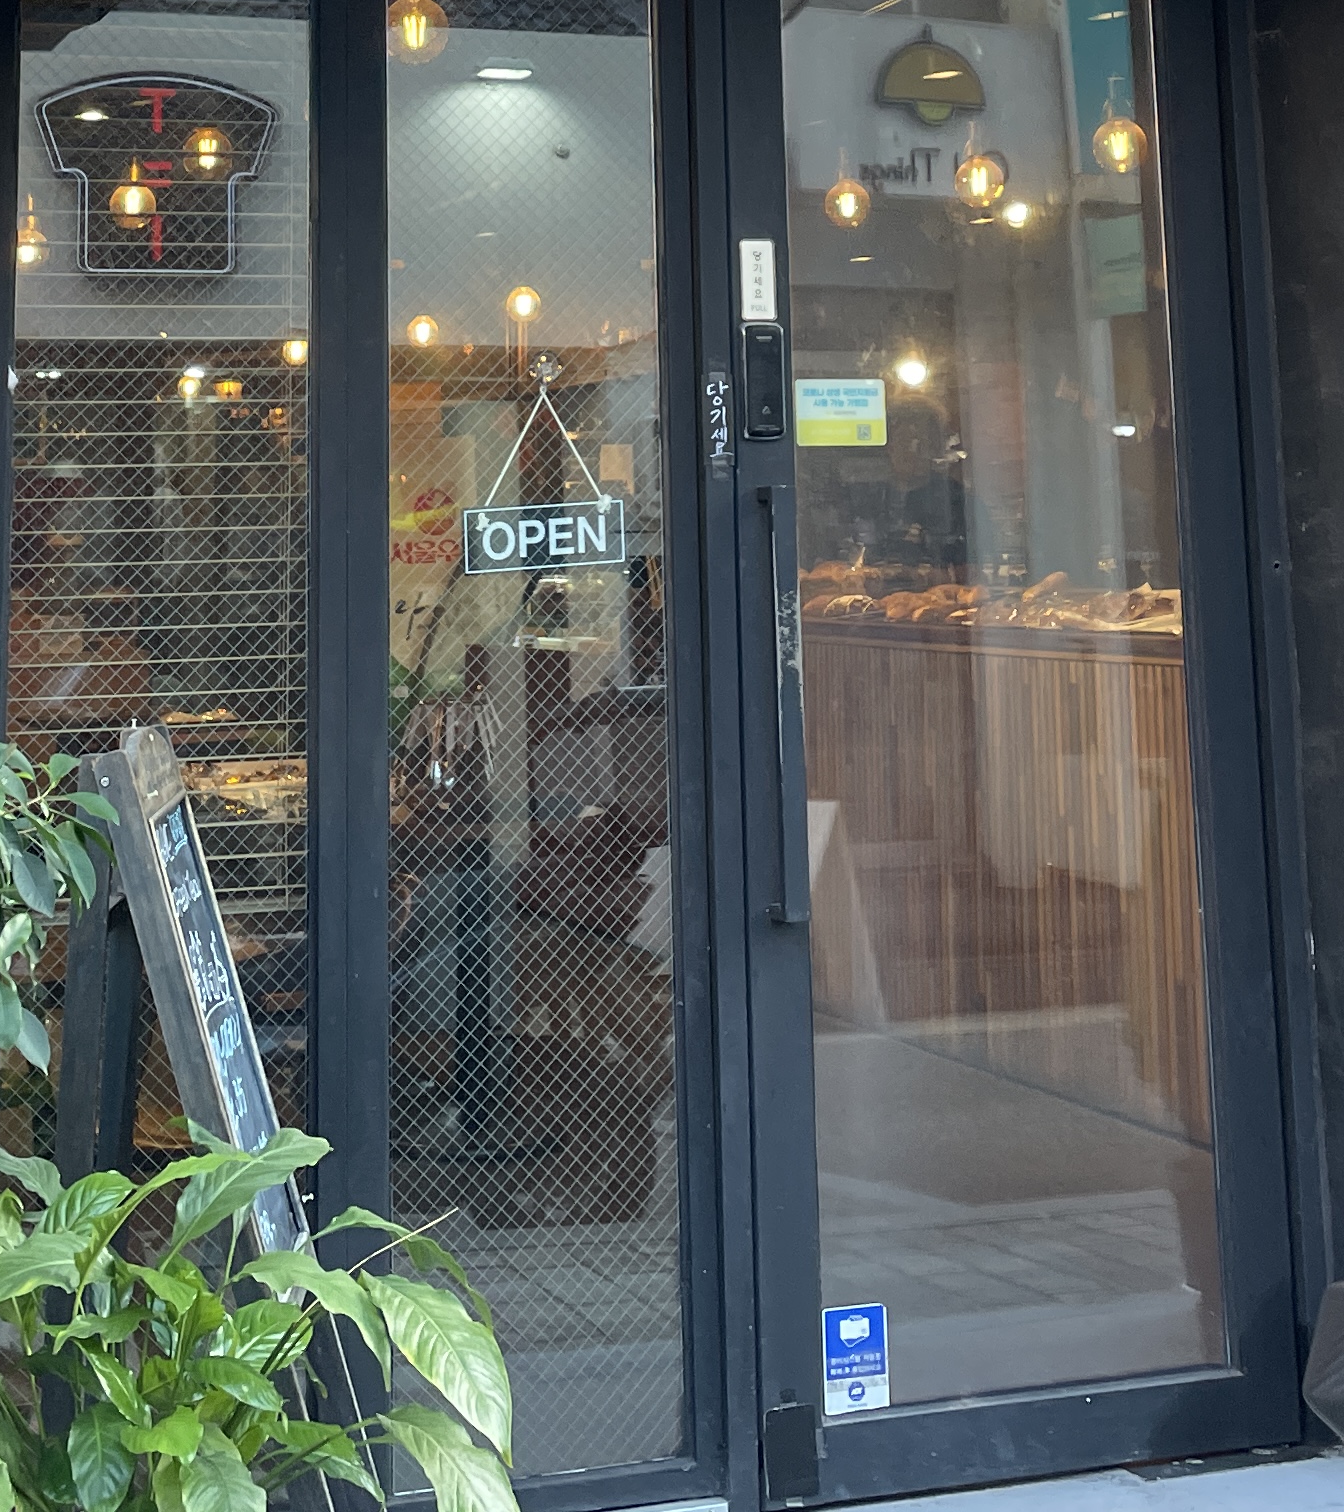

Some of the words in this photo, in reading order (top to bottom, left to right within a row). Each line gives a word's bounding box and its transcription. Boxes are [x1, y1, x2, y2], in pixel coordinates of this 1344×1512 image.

[752, 251, 763, 299] 당기세요
[750, 304, 768, 313] PULL
[482, 514, 607, 561] OPEN
